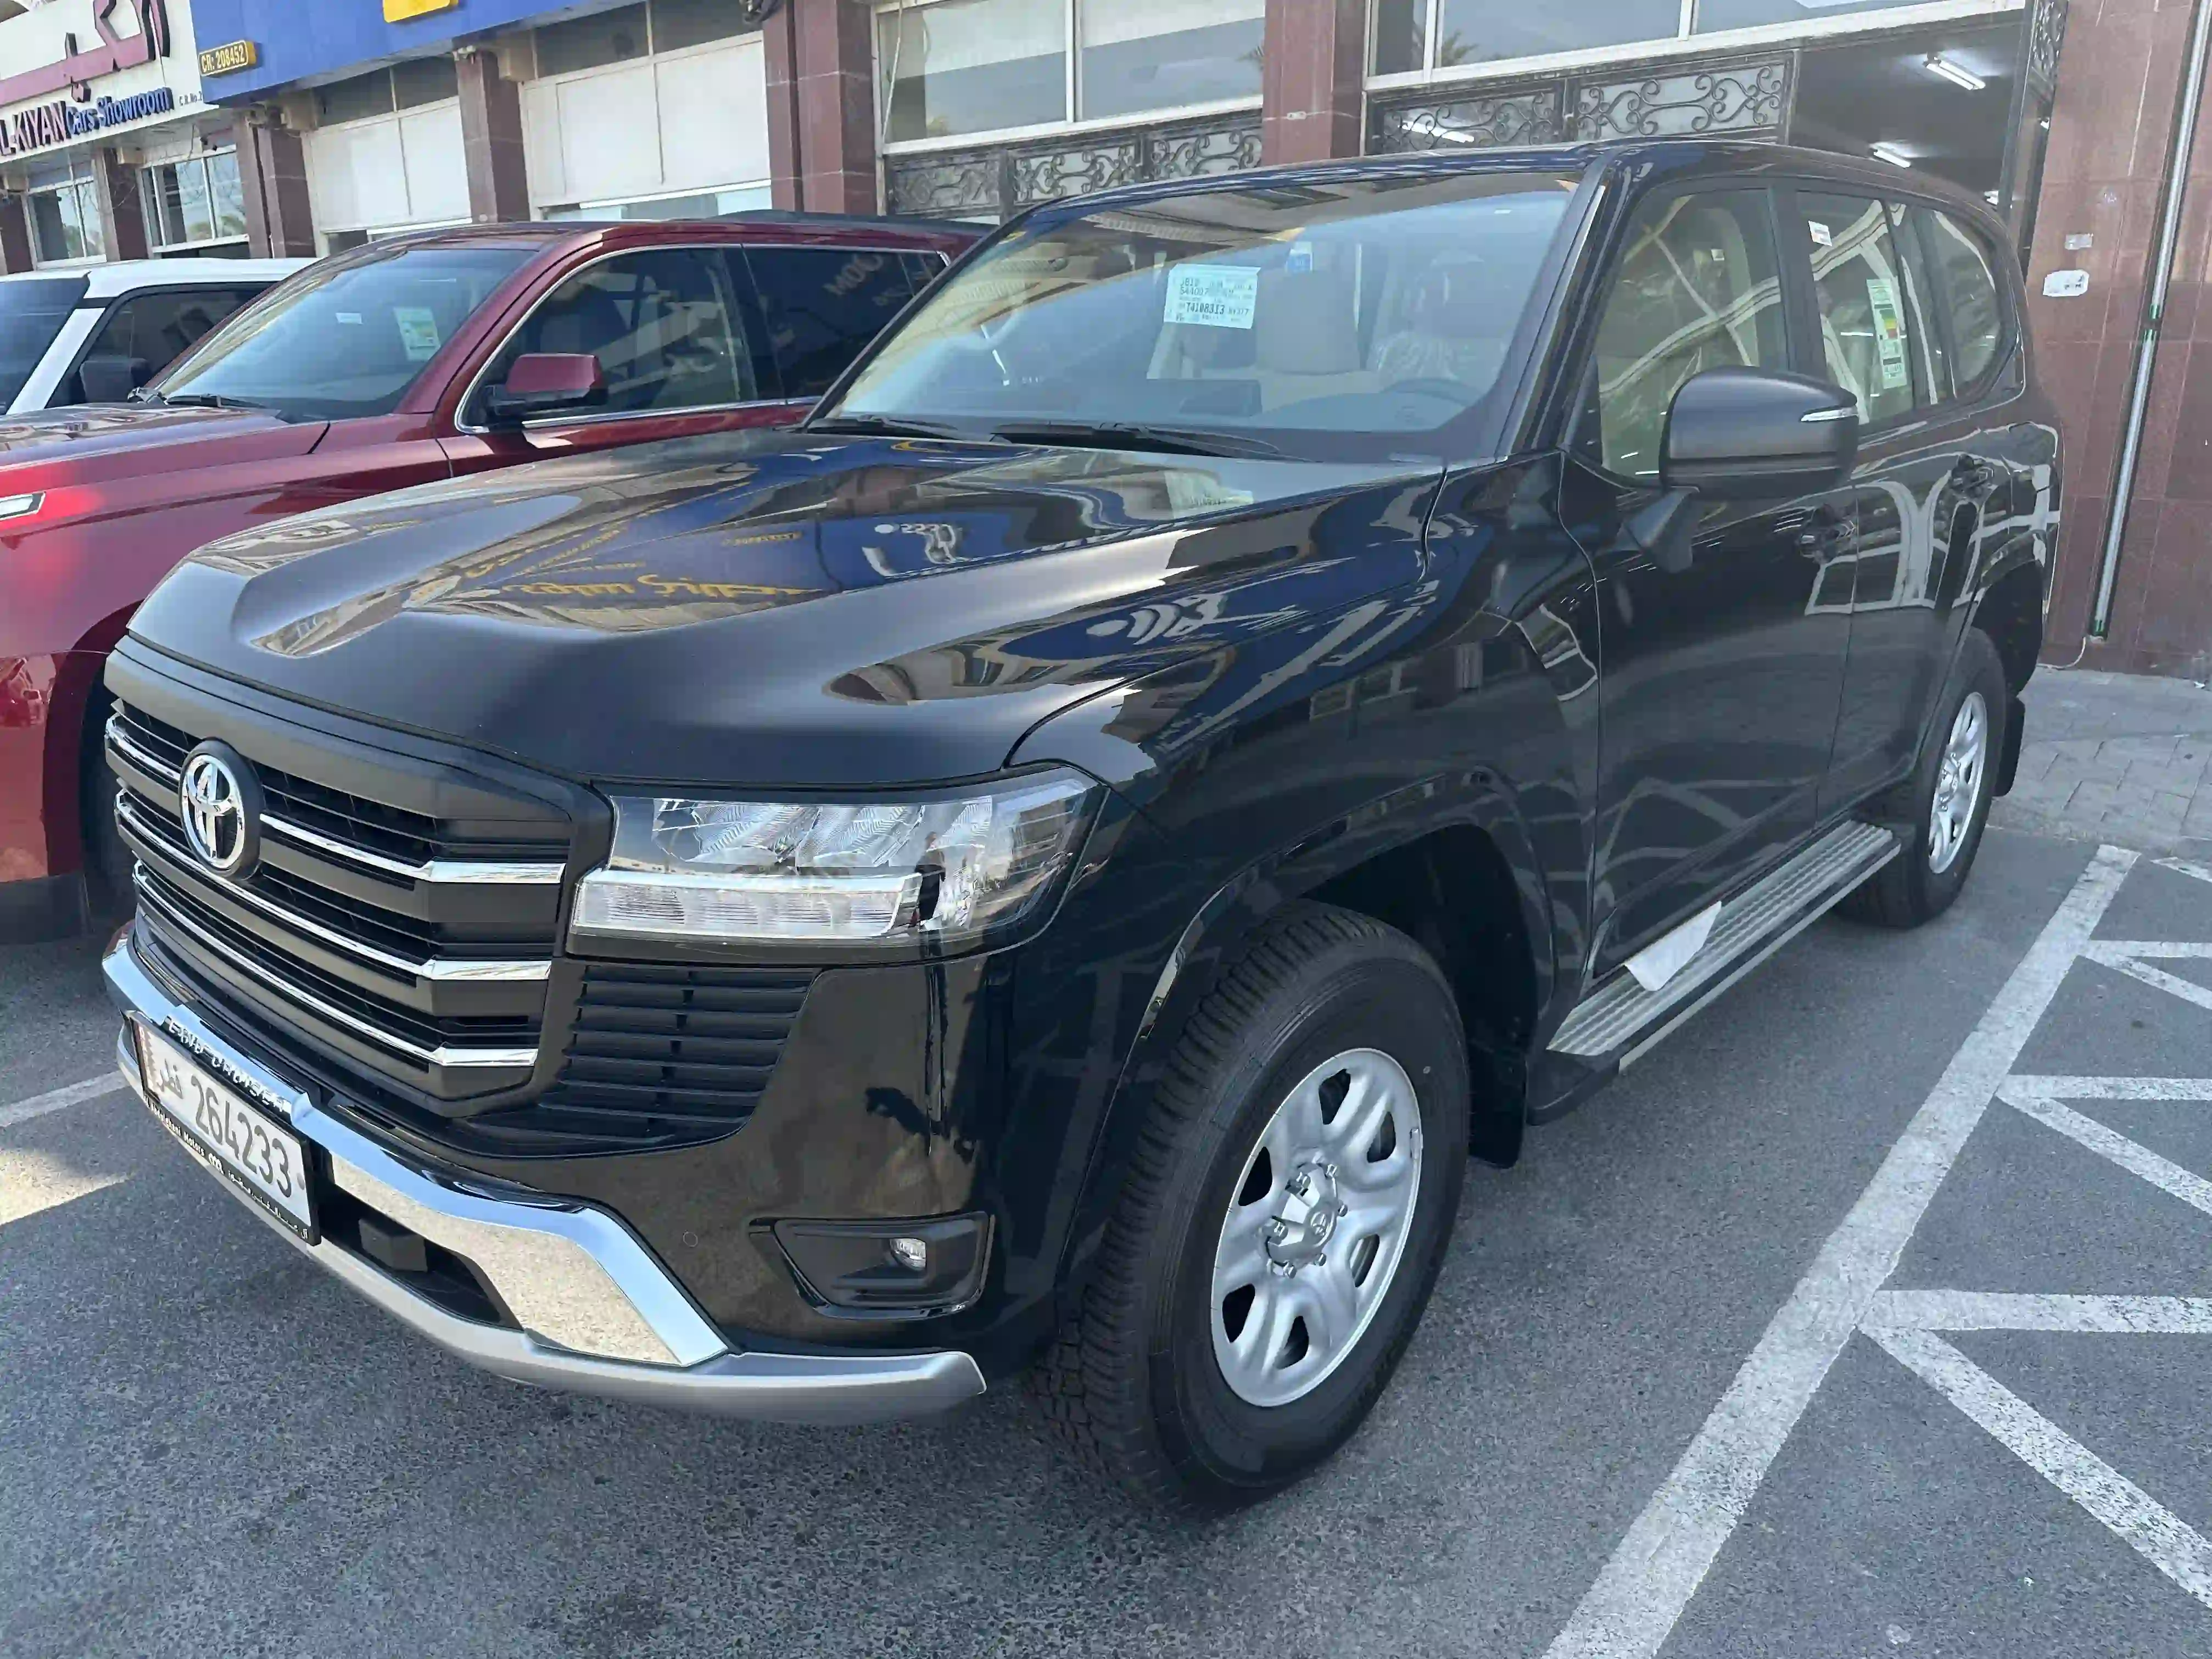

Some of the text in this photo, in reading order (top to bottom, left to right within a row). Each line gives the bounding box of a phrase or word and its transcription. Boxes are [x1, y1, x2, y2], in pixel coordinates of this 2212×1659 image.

[201, 44, 245, 73] CR: 208452
[65, 106, 100, 135] Cars
[97, 87, 174, 128] Showroom
[155, 1058, 184, 1099] قطر
[191, 1075, 293, 1198] 264233
